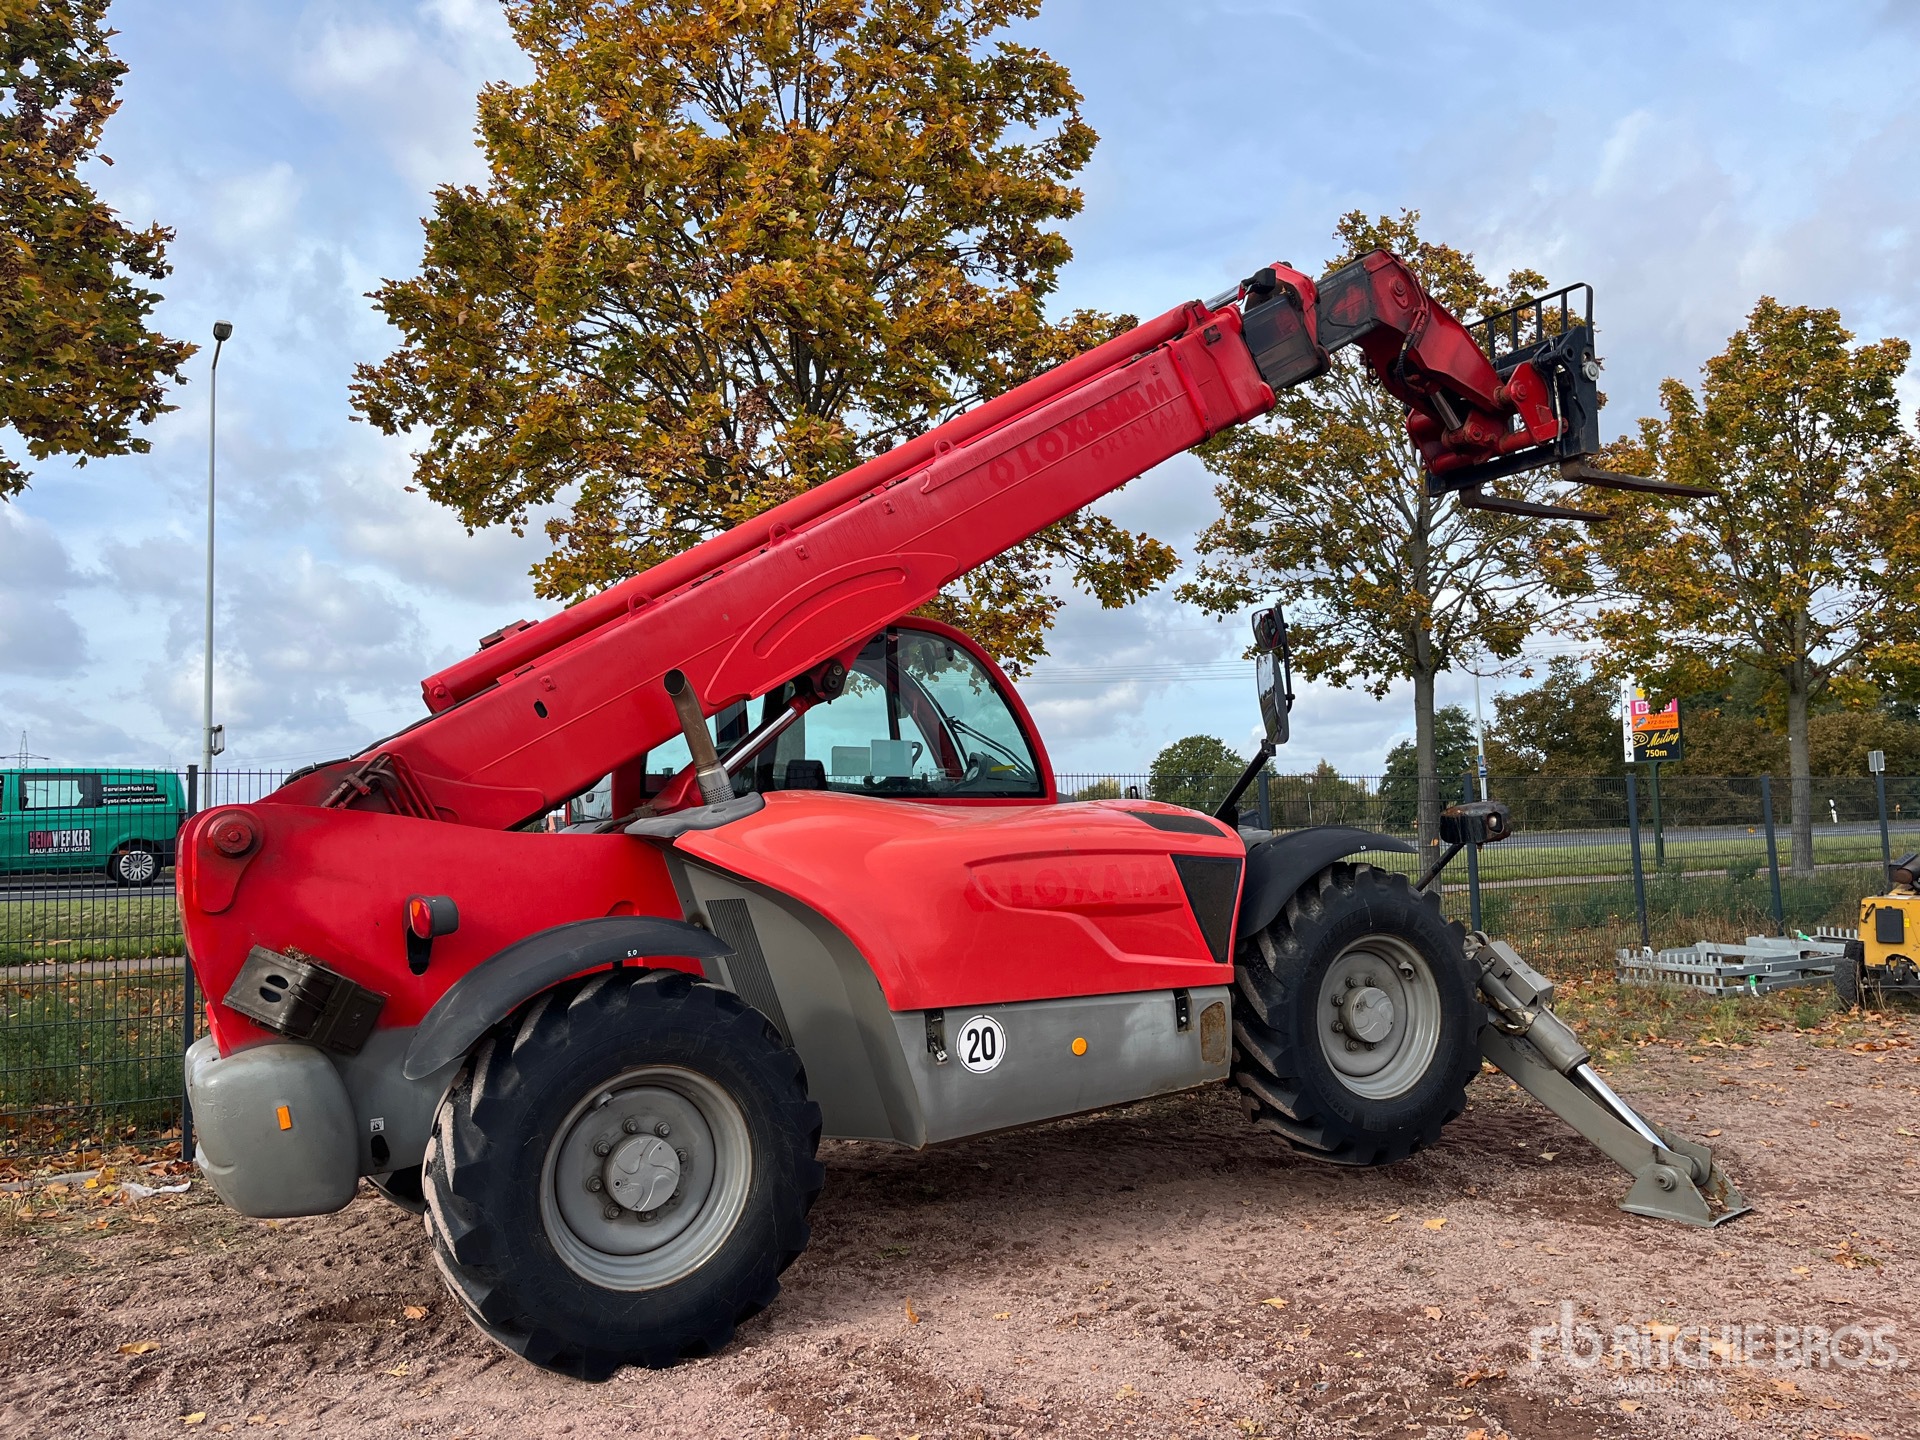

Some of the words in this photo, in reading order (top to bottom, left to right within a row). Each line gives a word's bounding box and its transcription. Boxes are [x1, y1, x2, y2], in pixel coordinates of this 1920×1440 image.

[1647, 729, 1679, 747] Meiling
[1645, 749, 1667, 757] 750m
[967, 1026, 996, 1064] 20
